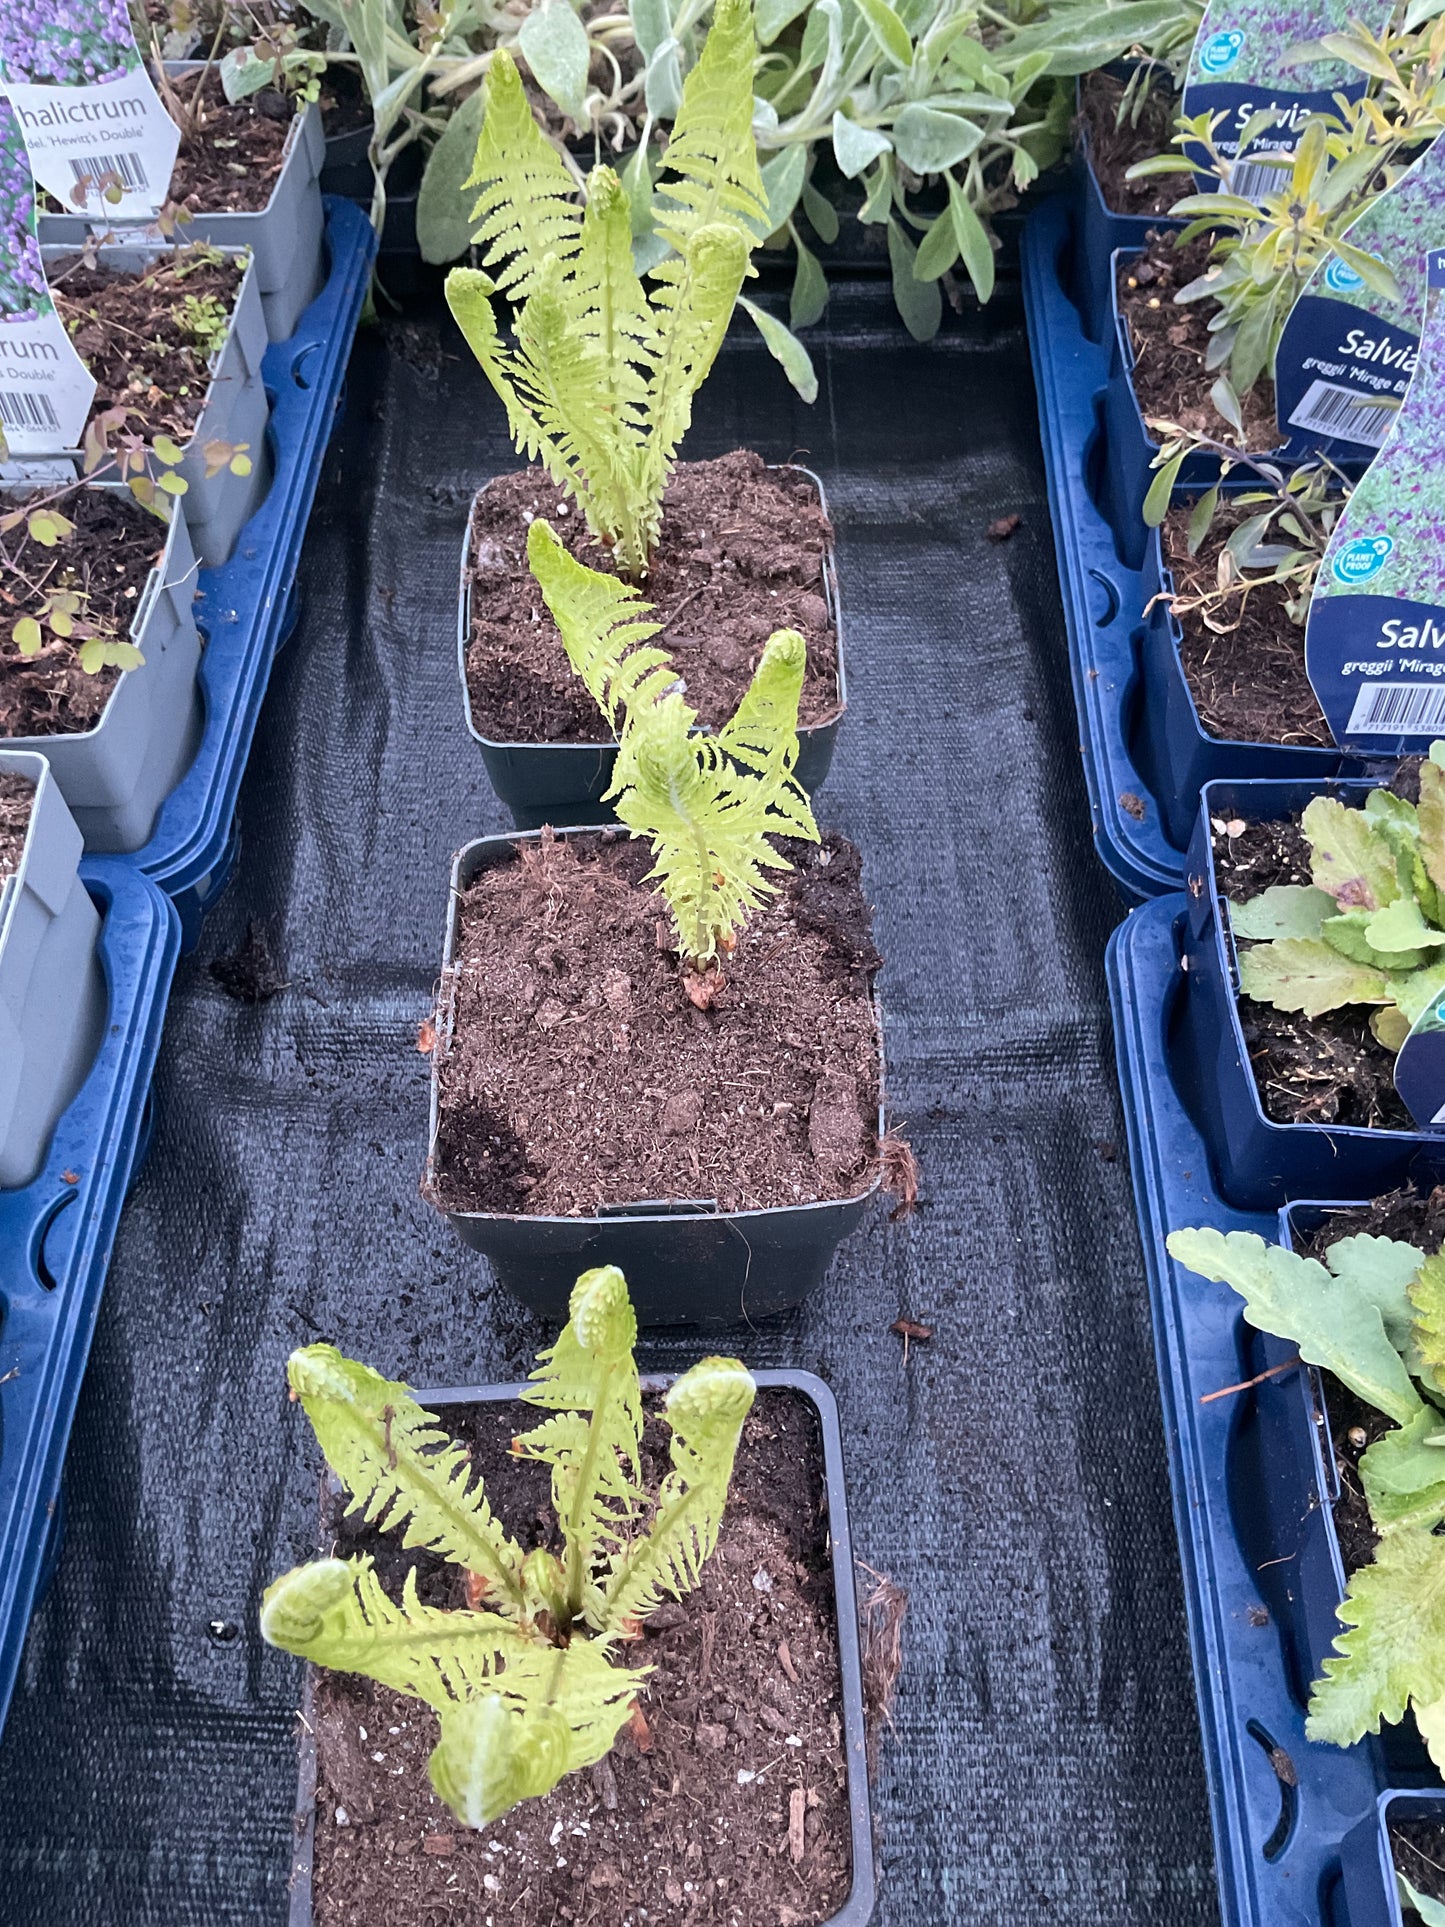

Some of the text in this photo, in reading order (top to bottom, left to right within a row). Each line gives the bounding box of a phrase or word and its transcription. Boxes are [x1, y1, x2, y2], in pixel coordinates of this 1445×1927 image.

[17, 98, 147, 128] halictrum
[1235, 102, 1311, 129] Svia
[99, 125, 144, 141] Double'
[0, 340, 59, 361] rum
[1338, 329, 1419, 372] Salvia
[6, 367, 55, 381] Double'
[1302, 357, 1347, 377] greggii
[1349, 366, 1392, 390] 'Mirage
[1345, 562, 1372, 571] PROOF
[1346, 553, 1376, 562] PLANET
[1376, 618, 1445, 648] Salv
[1341, 659, 1394, 676] greggii
